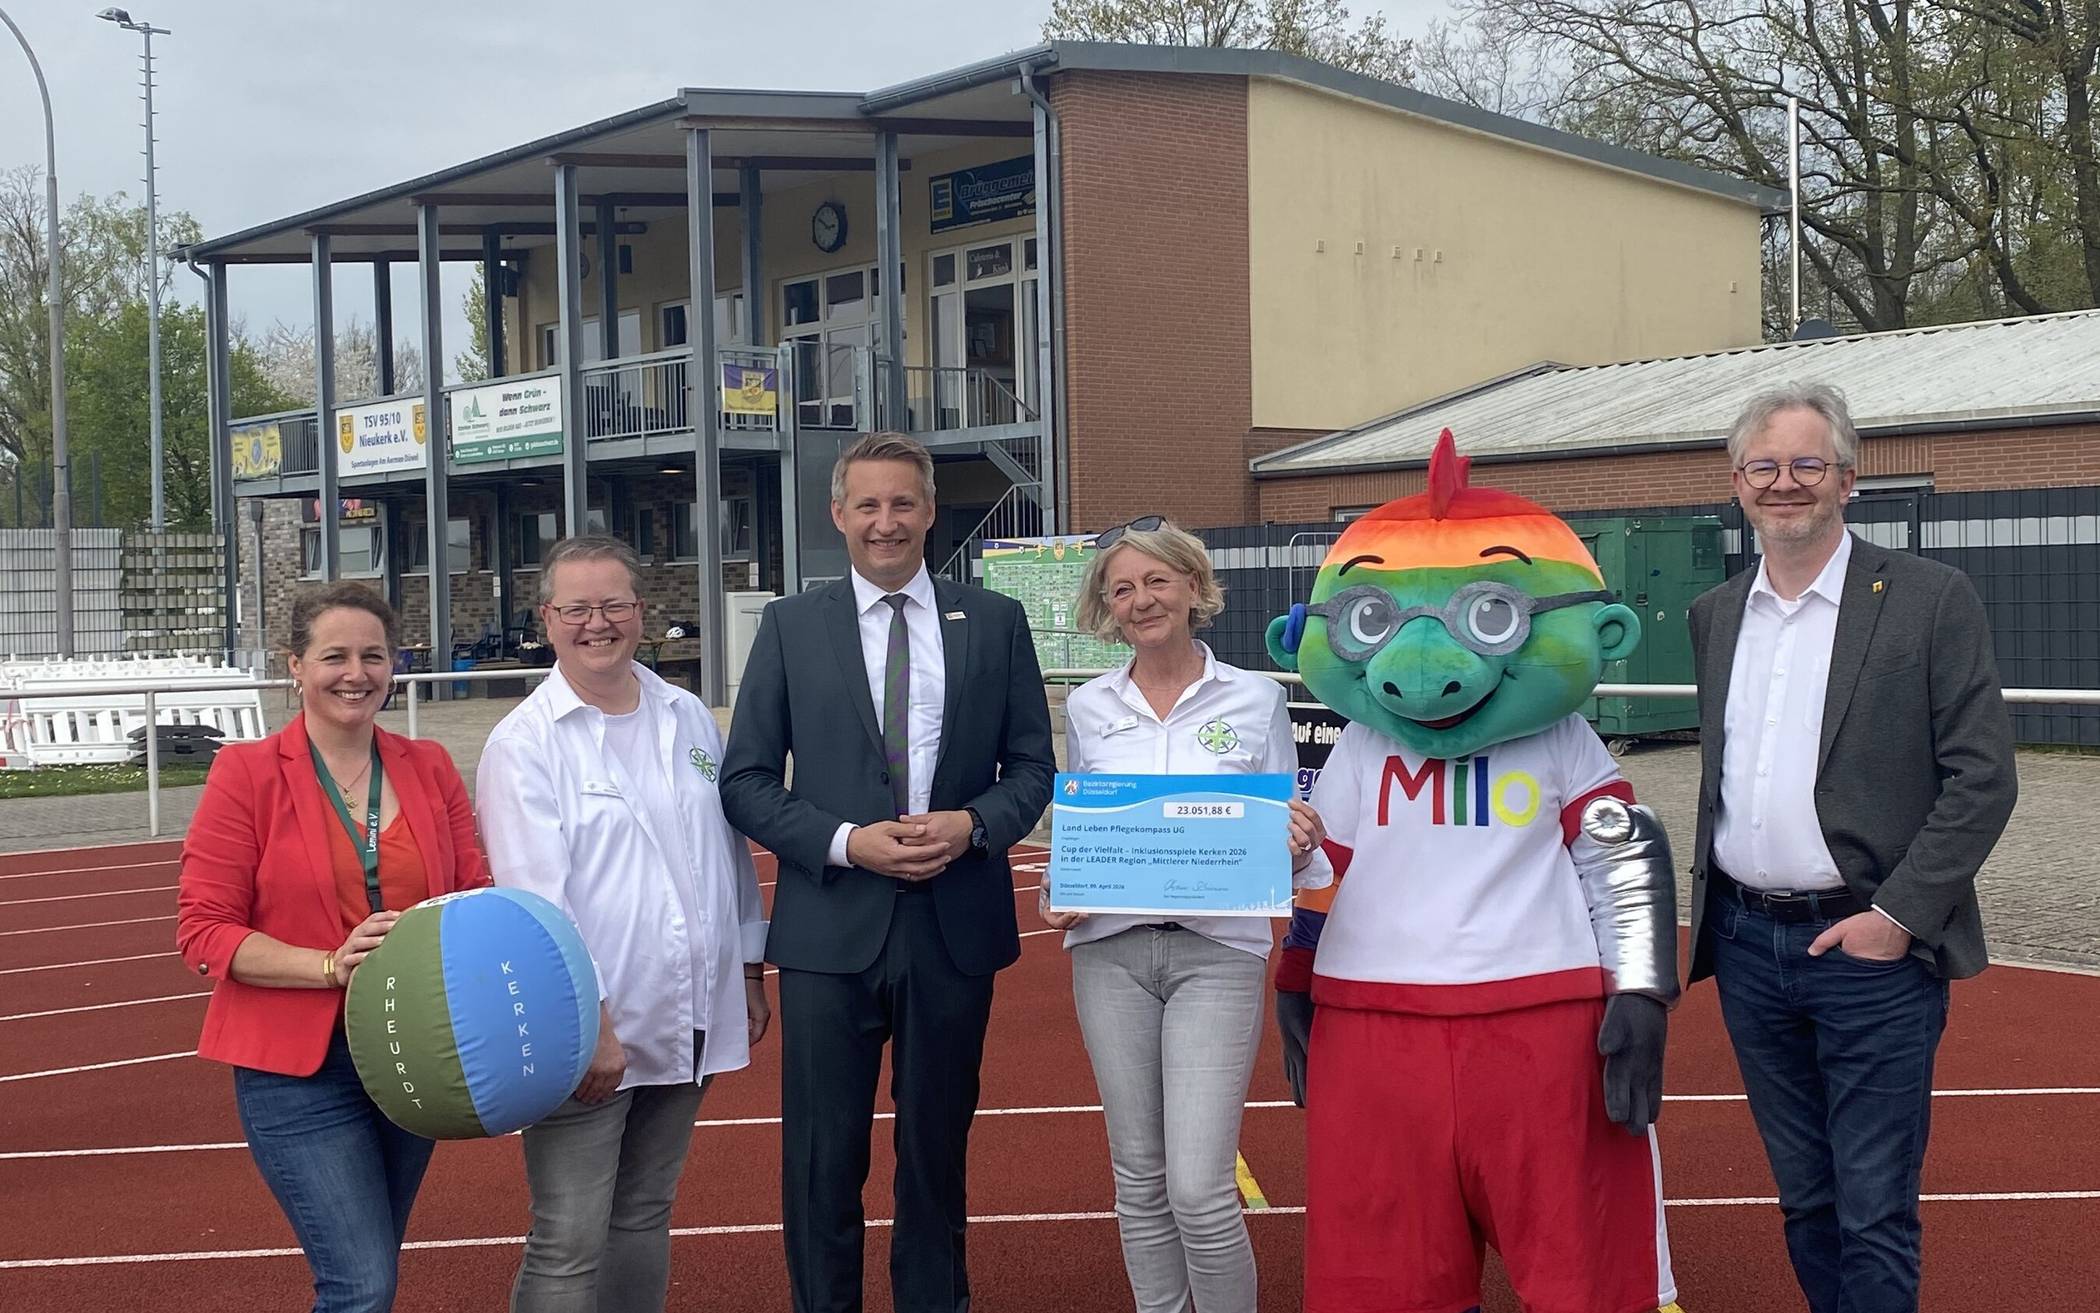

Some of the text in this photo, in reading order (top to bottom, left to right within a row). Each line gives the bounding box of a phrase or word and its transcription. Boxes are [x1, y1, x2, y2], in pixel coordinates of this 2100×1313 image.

[502, 392, 522, 402] Wenn
[523, 388, 542, 400] Grün
[499, 403, 551, 417] dann Schwarz
[364, 412, 401, 428] TSV 95/10
[359, 429, 408, 447] Nieukerk e.V.
[1291, 722, 1312, 744] Auf
[1297, 767, 1323, 794] g
[1377, 755, 1541, 828] Milo
[1177, 806, 1232, 816] 23.051,88 €
[1062, 824, 1185, 834] Land Leben Pflegekompass UG
[1061, 845, 1077, 854] Cup
[1094, 846, 1124, 854] Vielfalt
[1131, 847, 1197, 857] Inklusionsspiele
[1199, 848, 1227, 856] Kerken
[1228, 848, 1247, 856] 2026
[1061, 855, 1069, 863] in
[1070, 855, 1084, 863] der
[1119, 856, 1147, 866] Region
[501, 961, 535, 1076] KERKEN
[385, 976, 424, 1111] RHEURDT
